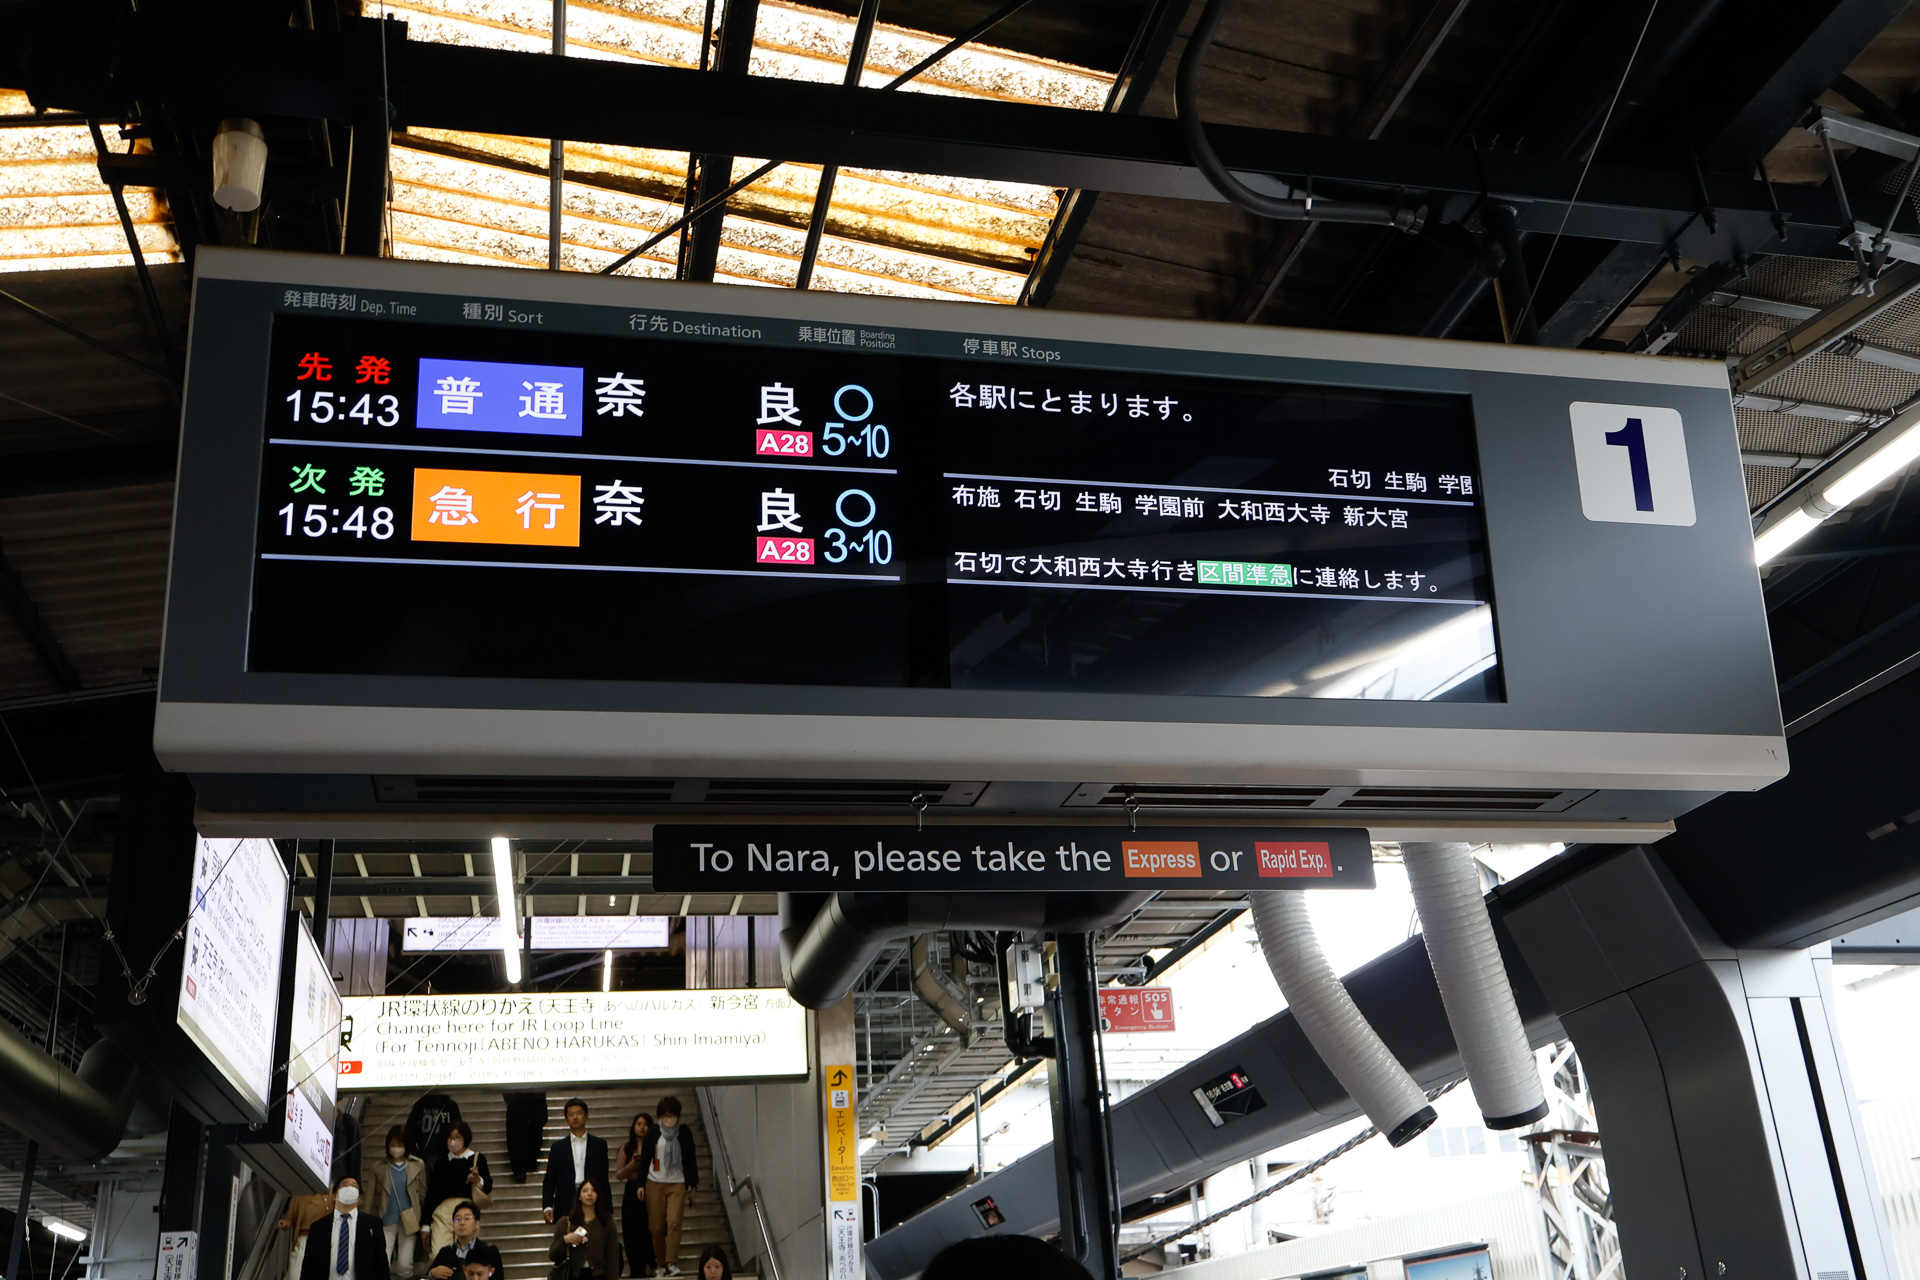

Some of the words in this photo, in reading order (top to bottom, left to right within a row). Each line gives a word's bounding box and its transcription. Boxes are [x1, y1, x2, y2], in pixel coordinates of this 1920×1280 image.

[284, 289, 356, 311] 発車時刻
[361, 300, 386, 315] Dep.
[390, 302, 417, 316] Time
[463, 303, 503, 321] 種別
[509, 310, 543, 324] Sort
[630, 314, 668, 331] 行先
[673, 320, 762, 339] Destination
[799, 326, 857, 346] 乗車位置
[861, 330, 895, 342] Boarding
[861, 339, 895, 350] Position
[963, 338, 1018, 357] 停車駅
[1022, 347, 1061, 362] Stops
[287, 390, 400, 427] 15:43
[949, 382, 1193, 422] 各駅にとまります。
[760, 434, 809, 454] A28
[1604, 417, 1655, 513] 1
[1329, 468, 1371, 491] 石切
[1384, 471, 1427, 493] 生駒
[952, 485, 1001, 509] 布施
[1015, 489, 1061, 512] 石切
[1075, 491, 1122, 515] 生駒
[1135, 494, 1205, 519] 学園前
[1218, 498, 1331, 526] 大和西大寺
[1344, 505, 1409, 530] 新大宮
[279, 503, 395, 540] 15:48
[760, 540, 810, 561] A28
[691, 844, 734, 873] To
[748, 844, 839, 877] Nara,
[855, 842, 962, 880] please
[972, 842, 1046, 872] take
[1056, 842, 1112, 872] the
[1128, 849, 1196, 873] Express
[1210, 850, 1244, 872] or
[1261, 849, 1297, 874] Rapid
[1300, 850, 1328, 874] Exp.
[710, 994, 759, 1011] 新今宮
[1144, 993, 1168, 1002] SOS
[377, 1021, 441, 1038] Change
[447, 1019, 485, 1034] here
[491, 1018, 515, 1032] for
[520, 1018, 538, 1032] JR
[544, 1017, 585, 1034] Loop
[591, 1016, 624, 1030] Line
[375, 1039, 409, 1055] (For
[654, 1029, 767, 1048] Shin-Imamiya)
[836, 1110, 846, 1165] エレベーター
